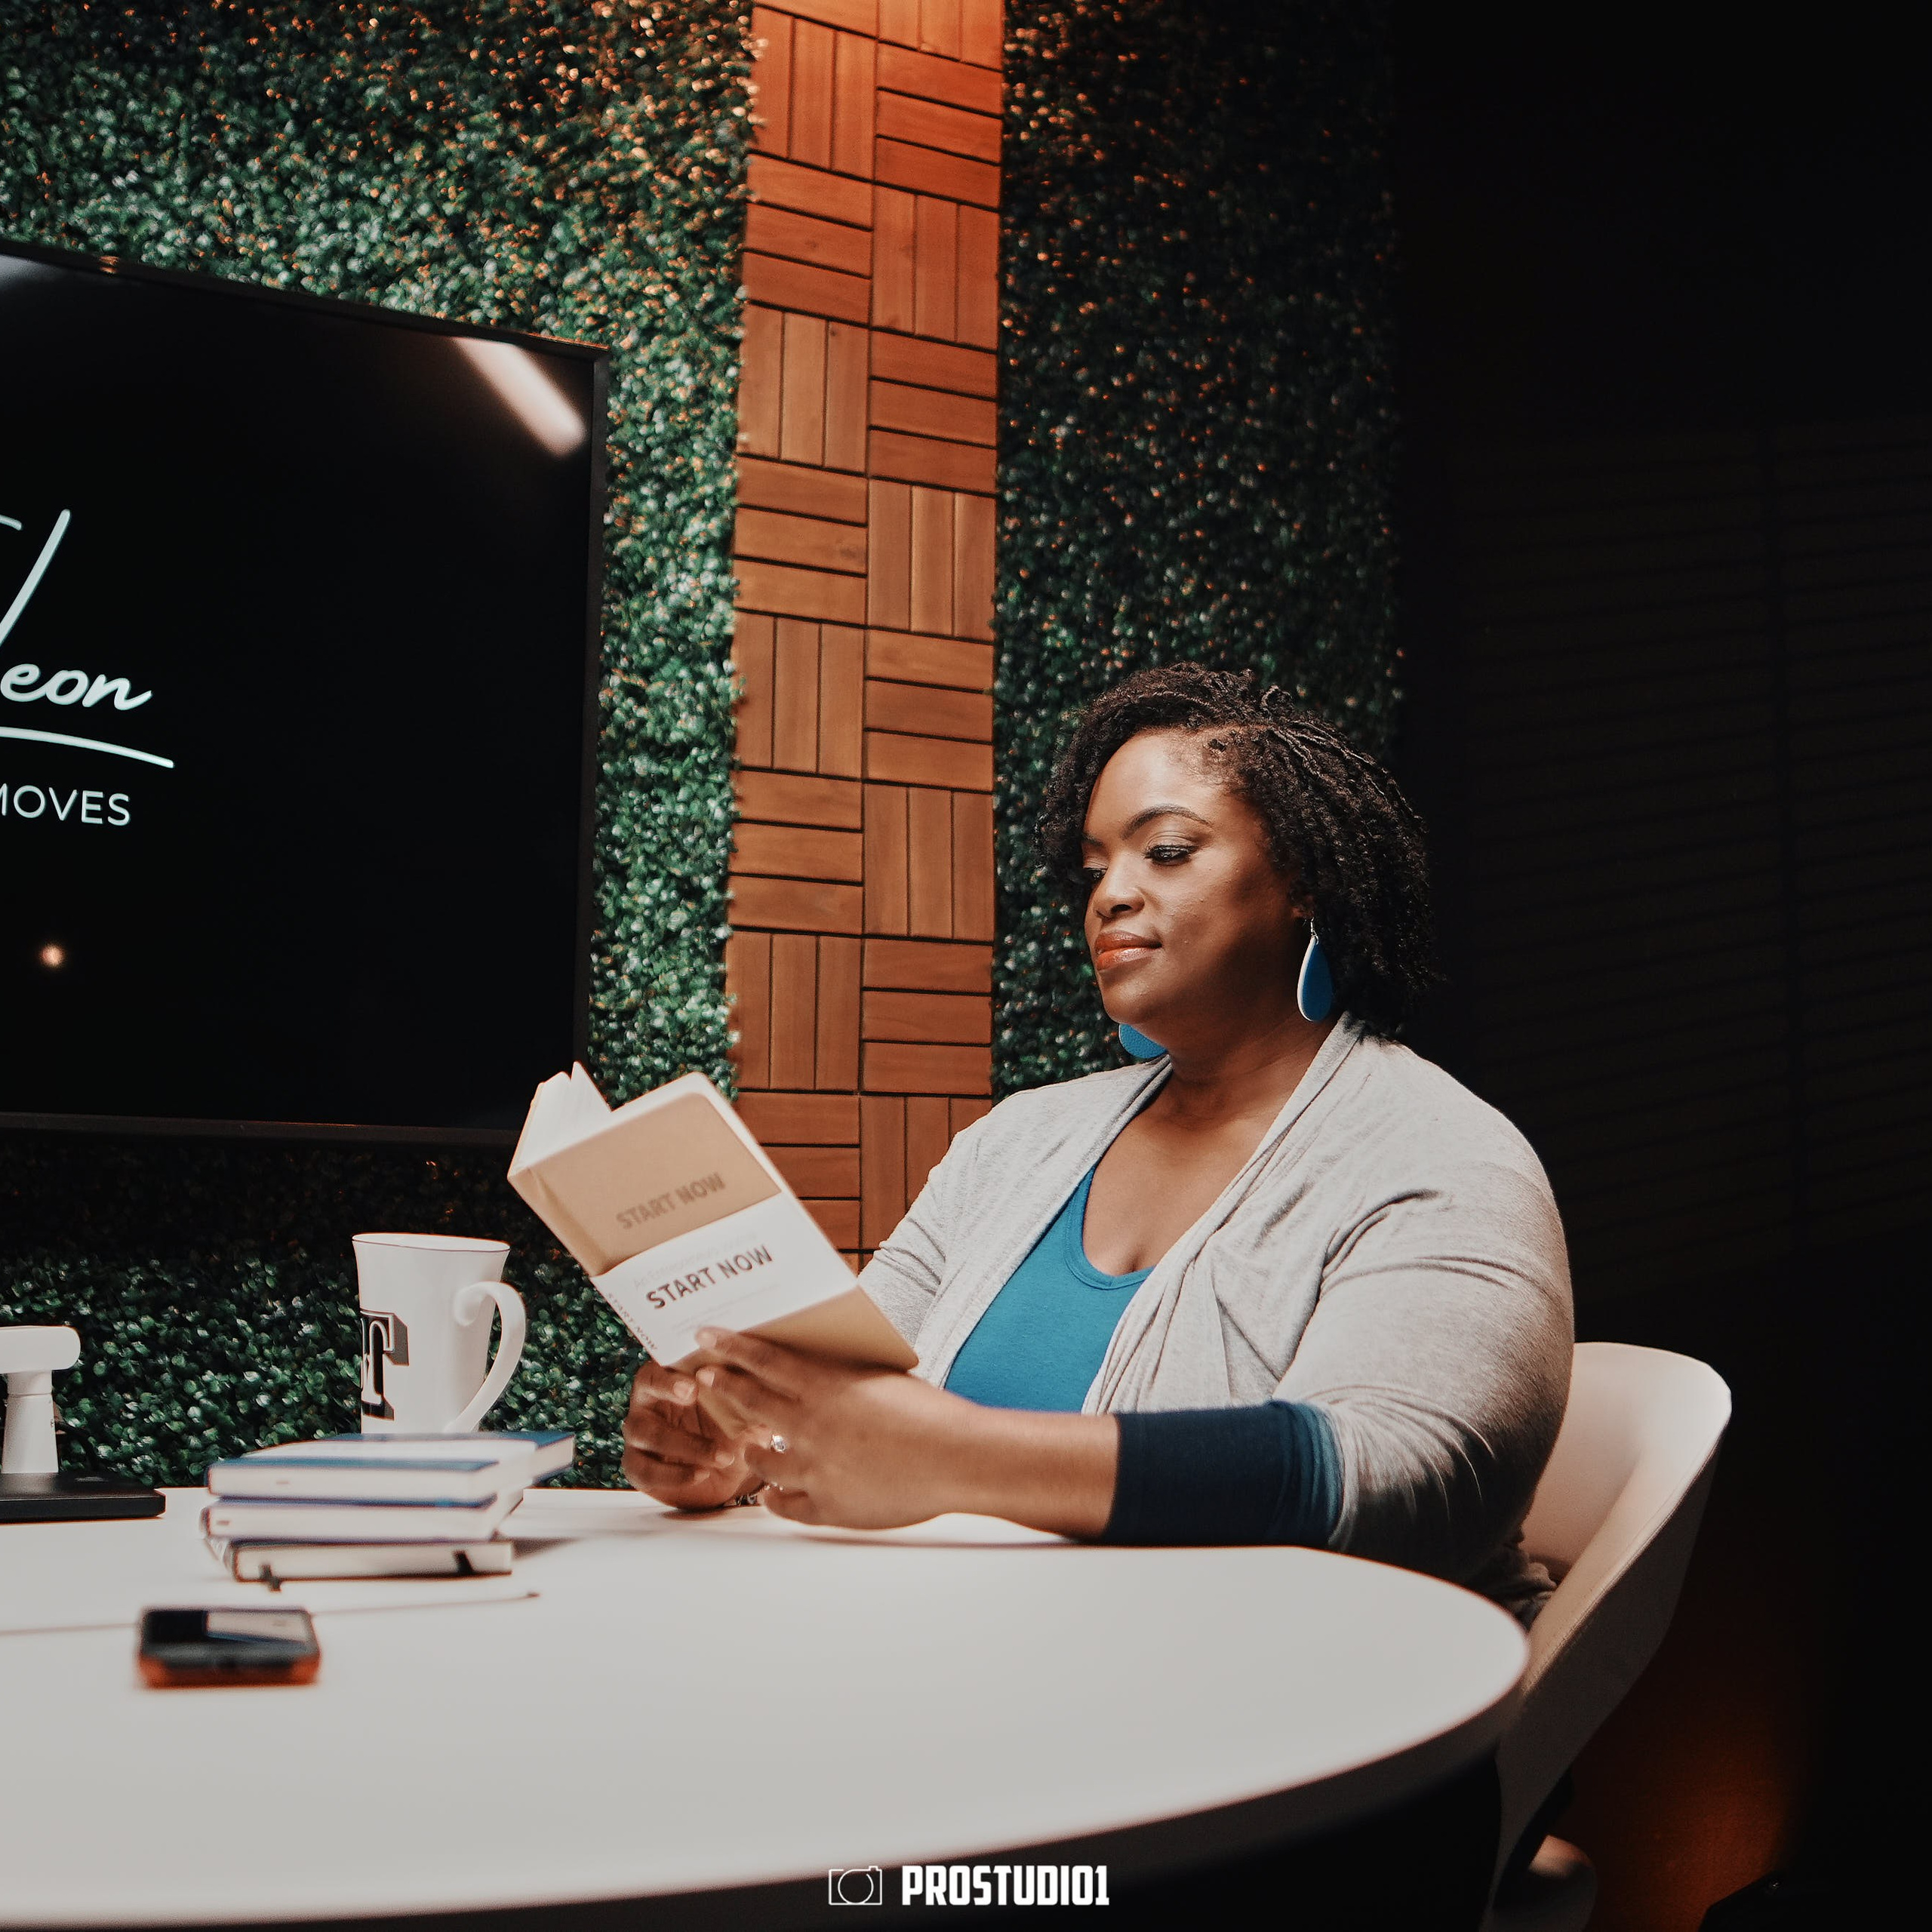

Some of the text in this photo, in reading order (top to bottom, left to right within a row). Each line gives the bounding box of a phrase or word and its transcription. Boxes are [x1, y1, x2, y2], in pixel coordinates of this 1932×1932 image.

[616, 1171, 726, 1229] START NOW
[646, 1267, 716, 1309] START
[716, 1244, 774, 1278] NOW
